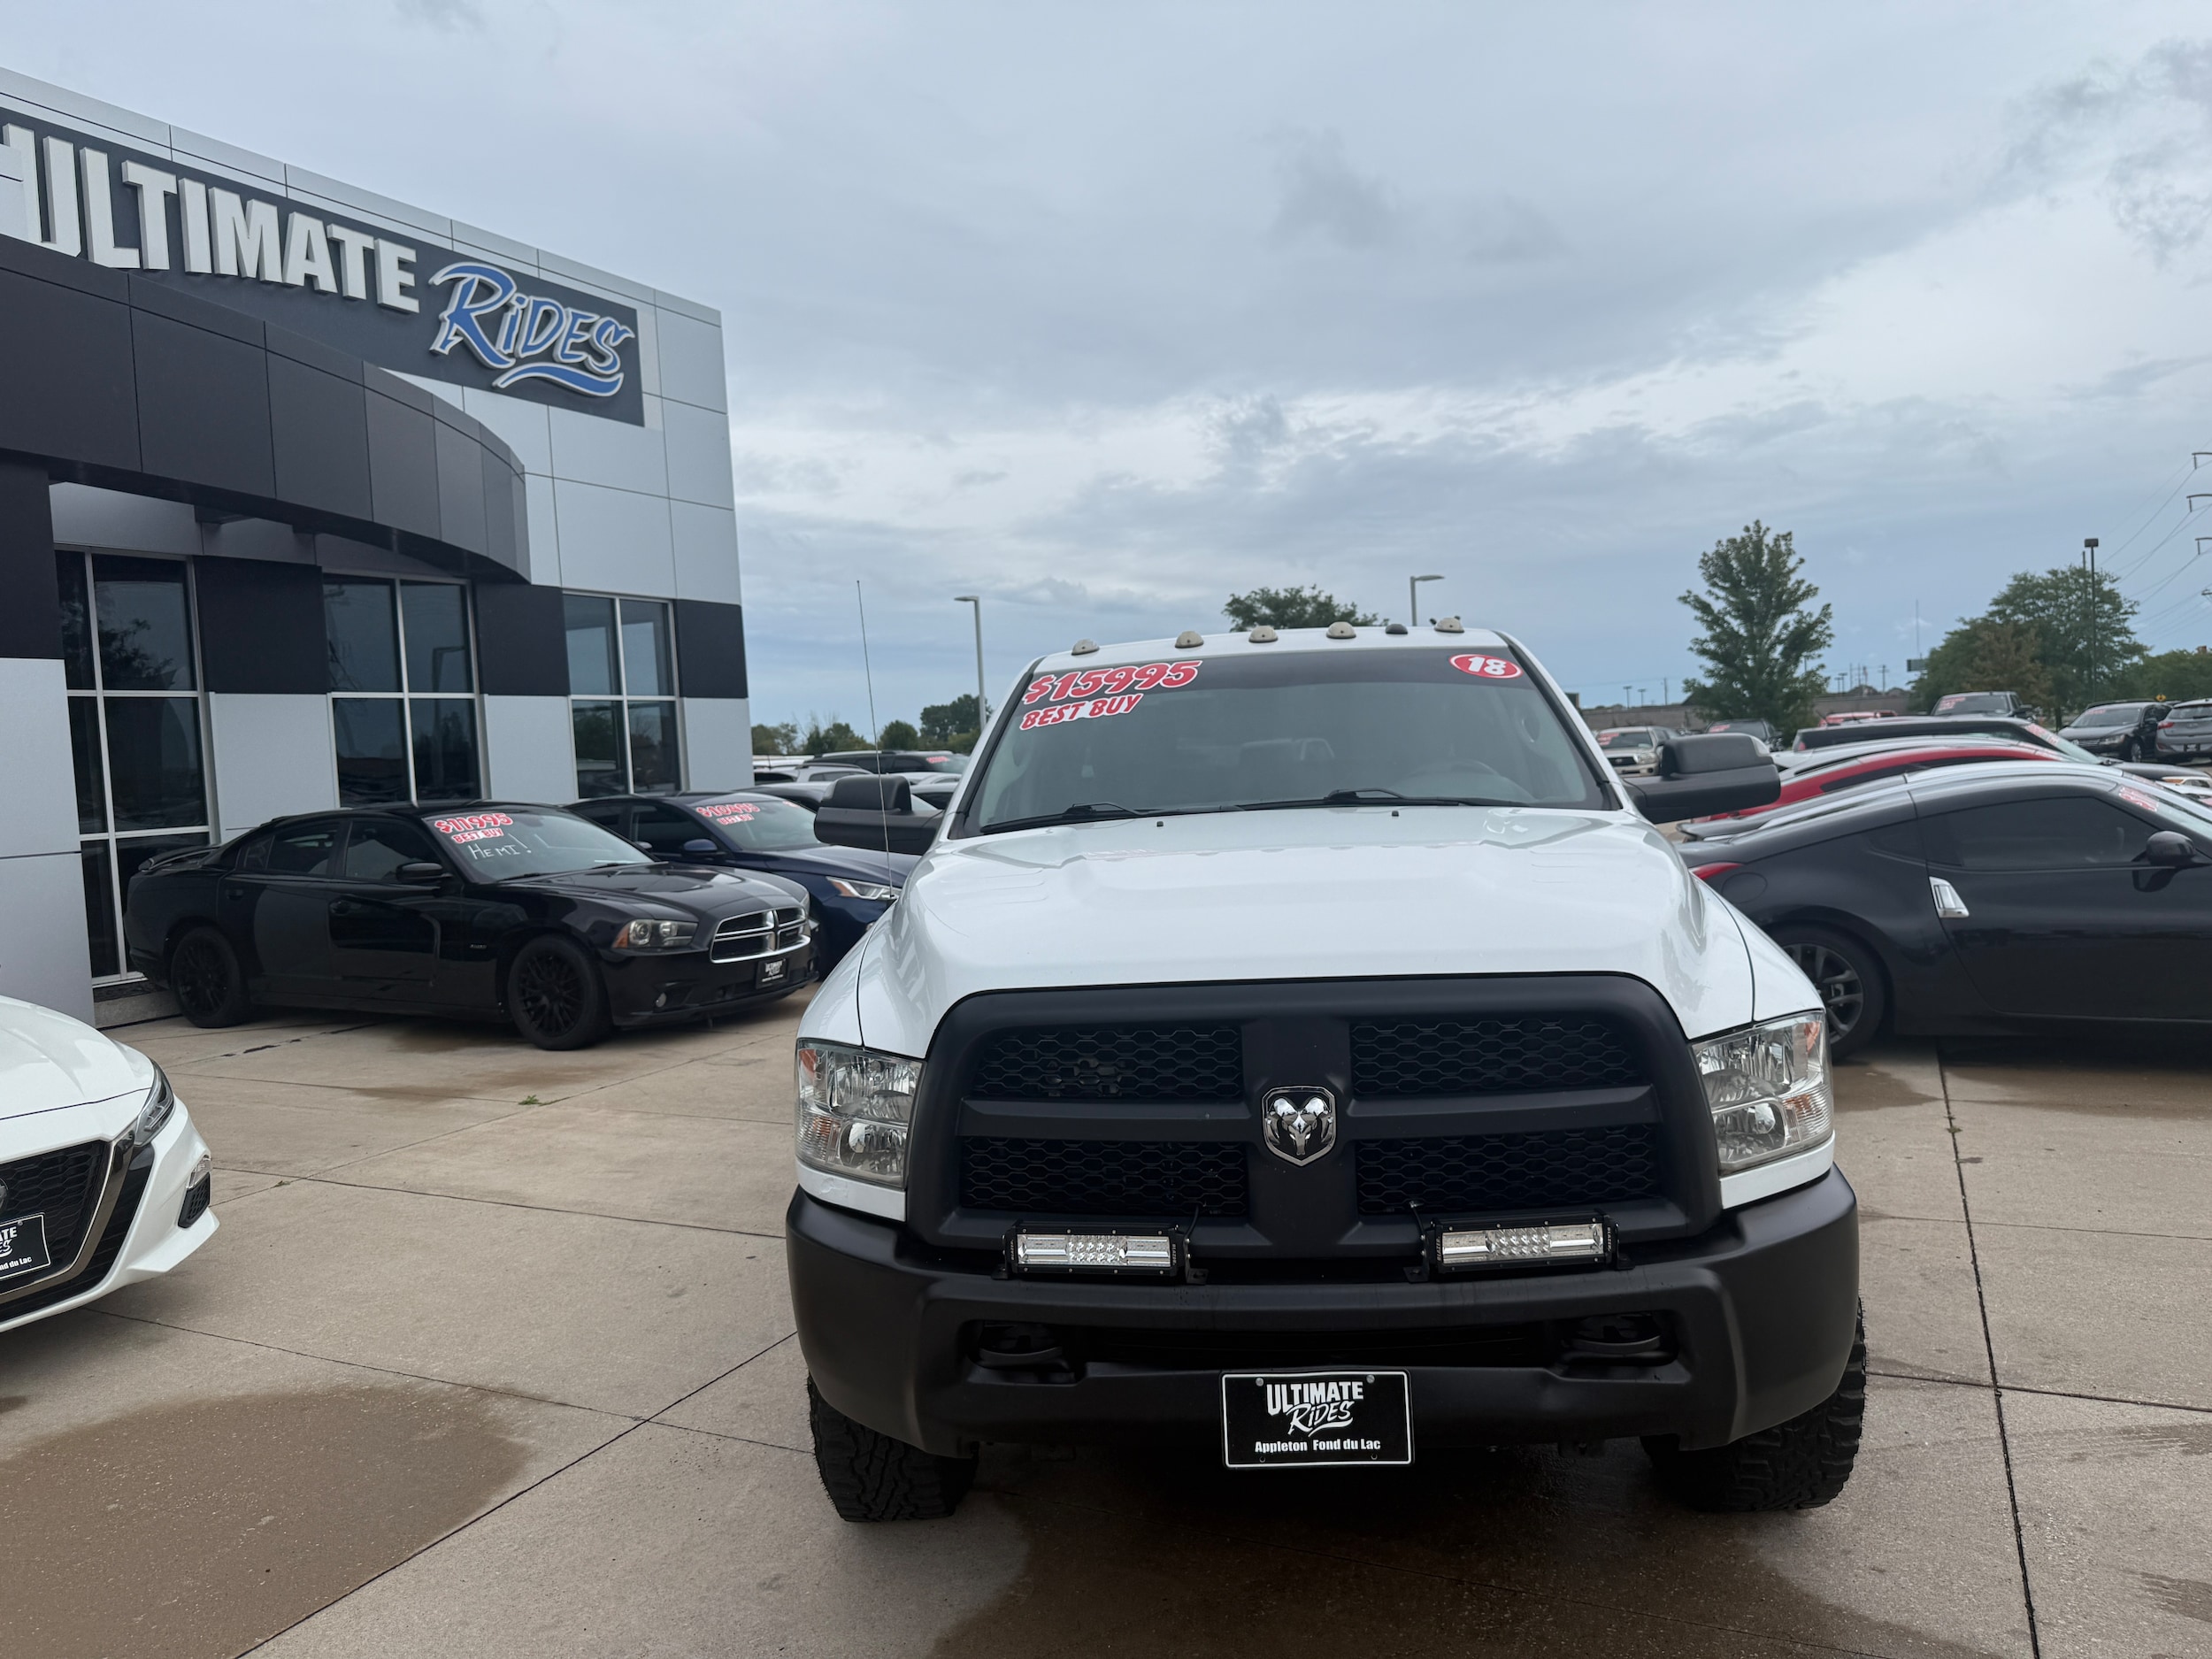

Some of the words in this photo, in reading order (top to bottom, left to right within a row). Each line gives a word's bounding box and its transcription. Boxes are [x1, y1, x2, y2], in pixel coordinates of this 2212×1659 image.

[3, 123, 420, 313] ULTIMATE
[1468, 656, 1507, 676] 18
[1022, 660, 1203, 704] $15995
[1019, 702, 1087, 731] BEST
[1088, 694, 1144, 718] BUY
[434, 812, 514, 834] $11995
[451, 830, 481, 844] BEST
[481, 827, 504, 839] BUY
[19, 1256, 33, 1265] Lac
[1266, 1381, 1363, 1416] ULTIMATE
[1255, 1440, 1308, 1454] Appleton
[1312, 1439, 1341, 1451] Fond
[1343, 1439, 1358, 1450] du
[1361, 1439, 1381, 1450] Lac
